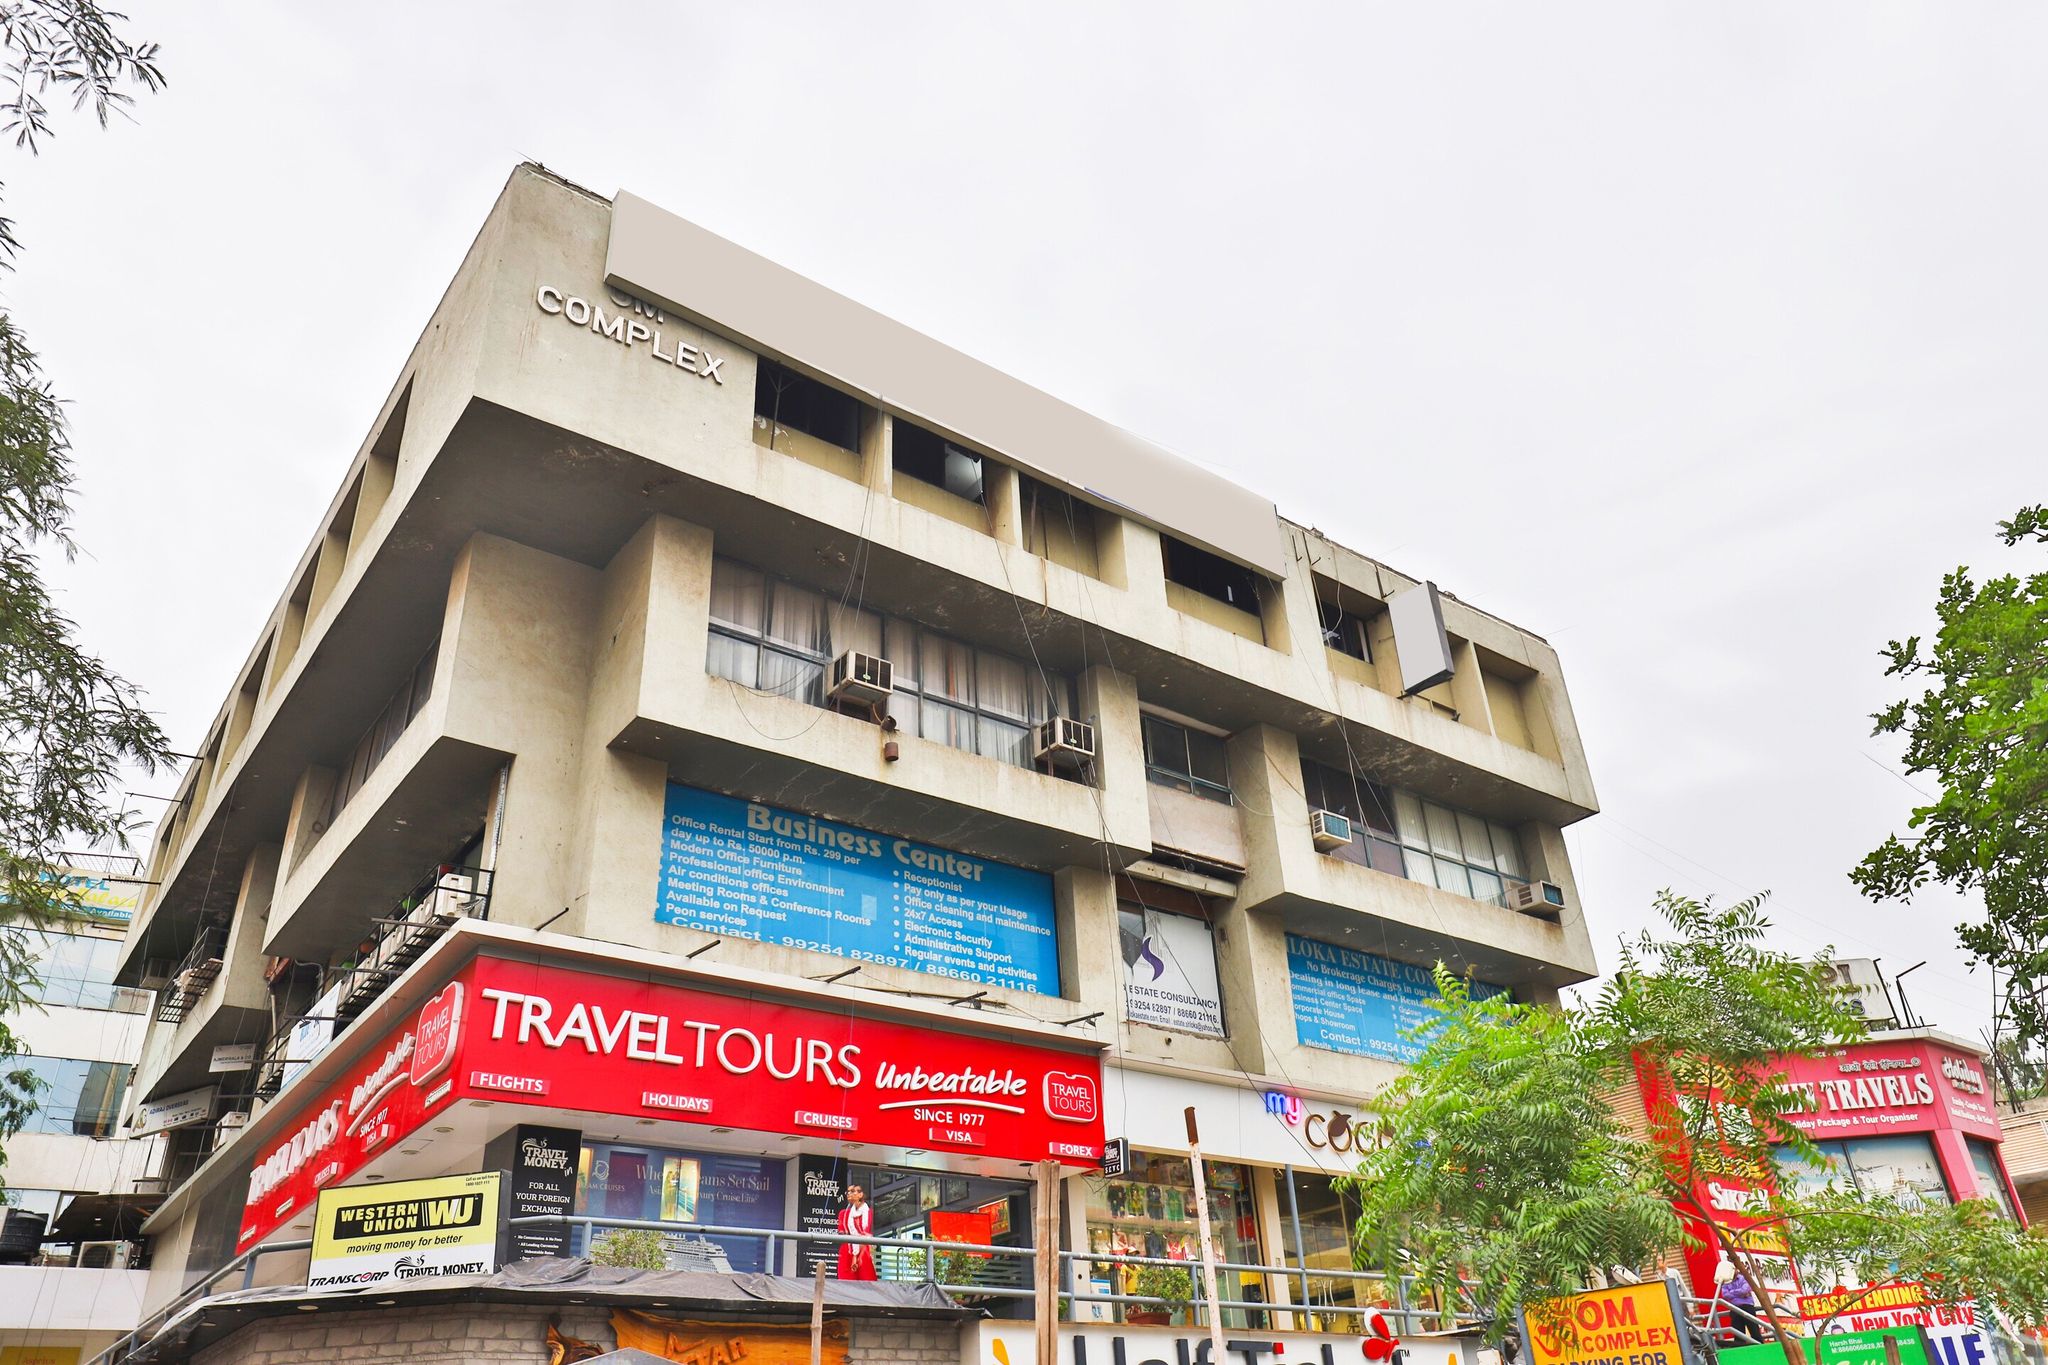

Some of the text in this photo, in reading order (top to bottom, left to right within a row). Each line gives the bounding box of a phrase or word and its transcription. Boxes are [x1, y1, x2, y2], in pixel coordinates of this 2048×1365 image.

[537, 285, 725, 385] COMPLEX
[671, 828, 806, 865] day up to Rs. 50000 p.m.
[672, 815, 861, 865] Office Rental Start from Rs. 299 per
[747, 804, 984, 882] Business Center
[670, 839, 803, 875] Modern Office Furniture
[668, 865, 788, 897] Air conditions offices
[669, 852, 845, 896] Professional office Environment
[904, 871, 963, 892] Receptionist
[666, 891, 787, 922] Available on Request
[667, 877, 872, 926] Meeting Rooms & Conference Rooms
[904, 883, 1028, 919] Pay only as per your Usage
[666, 903, 748, 927] Peon services
[904, 895, 1051, 936] Office cleaning and maintenance
[904, 908, 963, 929] 24x7 Access
[904, 920, 993, 949] Electronic Security
[672, 917, 981, 983] Contact 99254 82897 88660
[904, 933, 1012, 963] Administrative Support
[904, 946, 1038, 981] Regular events and activities
[1340, 950, 1401, 980] ESTATE
[1289, 970, 1322, 986] Dealing
[1325, 977, 1334, 987] in
[1336, 981, 1356, 994] long
[1382, 991, 1398, 1001] and
[1306, 961, 1318, 972] No
[1321, 965, 1366, 984] Brokerage
[1367, 975, 1402, 992] Charges
[1403, 982, 1412, 993] in
[1160, 991, 1218, 1009] CONSULTANCY
[1320, 998, 1363, 1014] Center Space
[1327, 989, 1366, 1006] office Space
[421, 1005, 449, 1038] TRAVEL
[1294, 1004, 1345, 1019] orporate House
[1295, 1013, 1356, 1031] hops & Showroom
[417, 1028, 448, 1067] TOURS
[1320, 1029, 1399, 1053] Contact 99254
[479, 1073, 543, 1092] FLIGHTS
[875, 1061, 1027, 1096] Unbeatable
[649, 1092, 710, 1111] HOLIDAYS
[1051, 1082, 1091, 1100] TRAVEL
[1819, 1073, 1935, 1111] TRAVELS
[1052, 1095, 1092, 1113] TOURS
[1264, 1091, 1302, 1125] my
[359, 1118, 376, 1138] SINCE
[803, 1112, 853, 1128] CRUISES
[913, 1108, 985, 1126] SINCE 1977
[1817, 1116, 1851, 1128] Package
[1852, 1116, 1859, 1125] &
[1860, 1114, 1878, 1124] Tour
[1880, 1112, 1919, 1124] Organiser
[946, 1129, 972, 1143] VISA
[525, 1147, 568, 1160] TRAVEL
[1059, 1143, 1093, 1157] FOREX
[523, 1156, 567, 1169] MONEY
[528, 1181, 560, 1191] FOR ALL
[600, 1183, 625, 1192] CRUISES
[728, 1174, 770, 1191] Set Sail
[806, 1186, 839, 1197] MONEY
[807, 1178, 840, 1190] TRAVEL
[515, 1192, 571, 1203] YOUR FOREIGN
[716, 1192, 740, 1202] Cruise
[340, 1202, 419, 1222] WESTERN
[426, 1197, 475, 1227] WU
[521, 1204, 563, 1214] EXCHANGE
[803, 1216, 819, 1224] YOUR
[811, 1207, 823, 1215] FOR
[363, 1217, 418, 1233] UNION
[346, 1233, 463, 1255] moving money for better
[309, 1261, 485, 1287] TRANSCORP TRAVEL MONEY
[1802, 1284, 1924, 1317] SEASON ENDING
[1577, 1296, 1638, 1331] OM
[1851, 1304, 1975, 1332] New York City
[1582, 1326, 1677, 1353] COMPLEX
